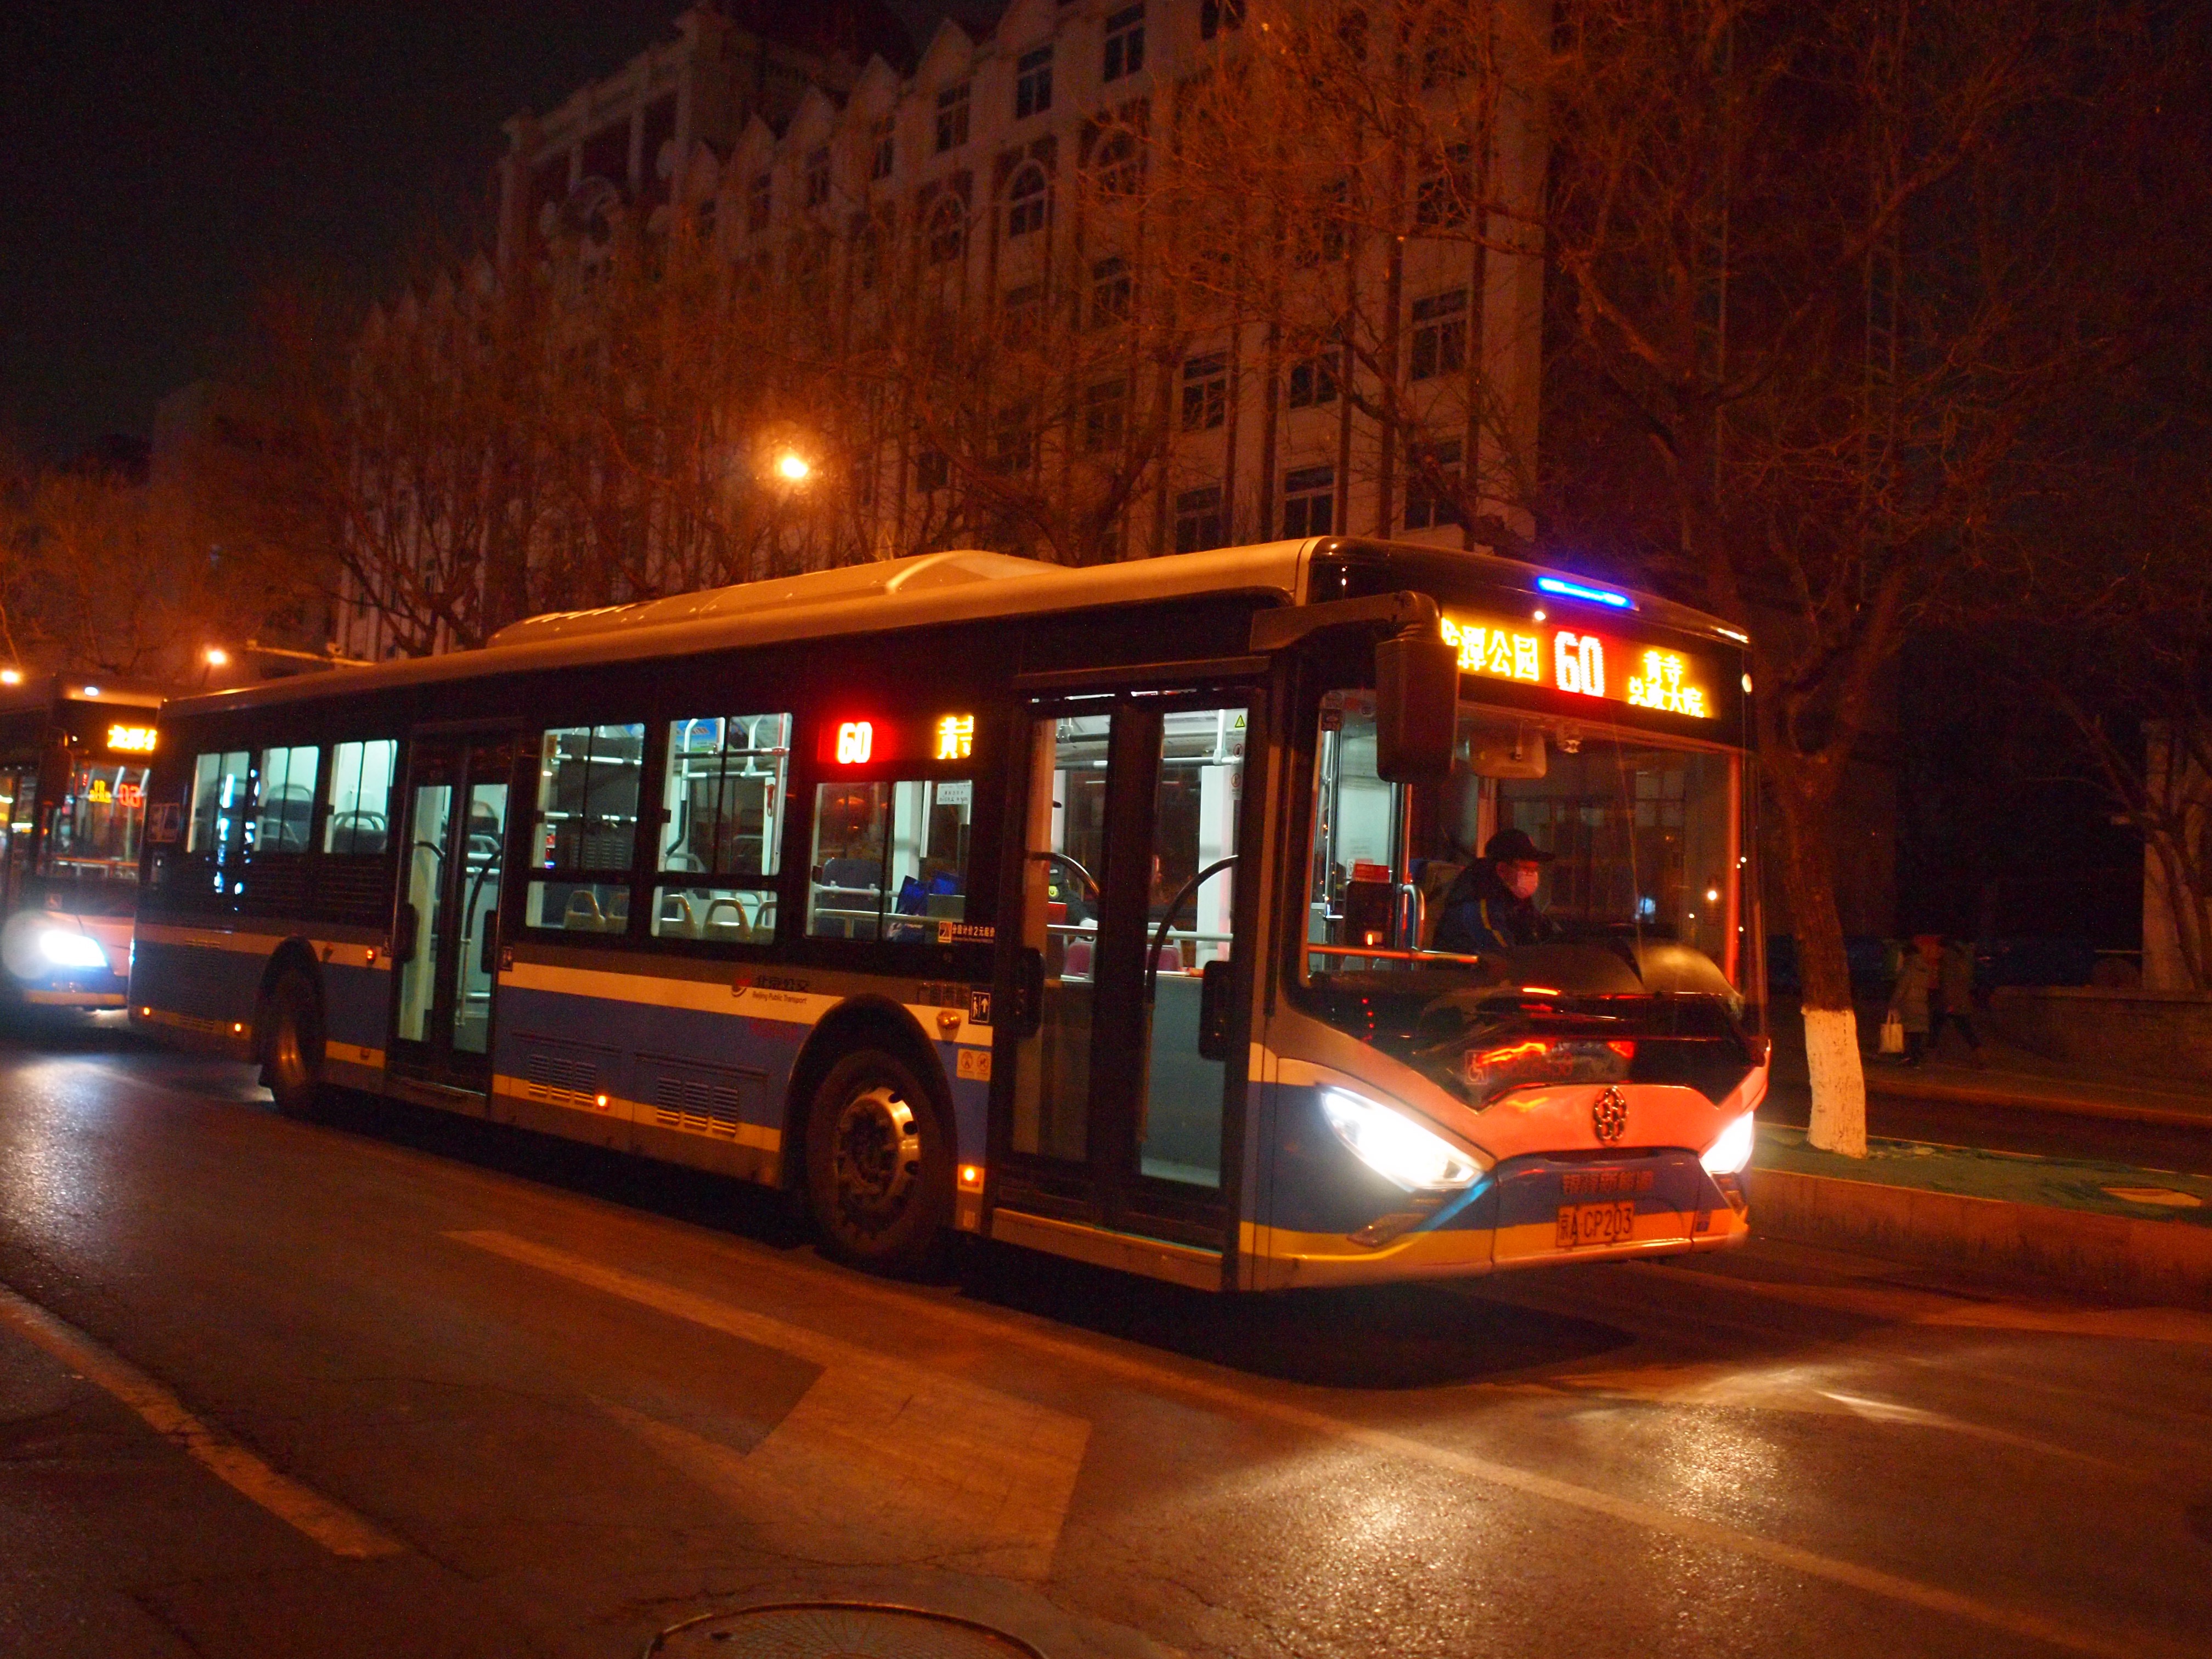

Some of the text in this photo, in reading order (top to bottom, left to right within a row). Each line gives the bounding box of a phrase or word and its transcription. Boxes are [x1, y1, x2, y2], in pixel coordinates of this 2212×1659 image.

[1555, 631, 1605, 697] 60
[1643, 650, 1683, 686] 黄寺
[1628, 676, 1705, 718] 总政大院
[837, 721, 873, 764] 60
[769, 992, 782, 1001] Public
